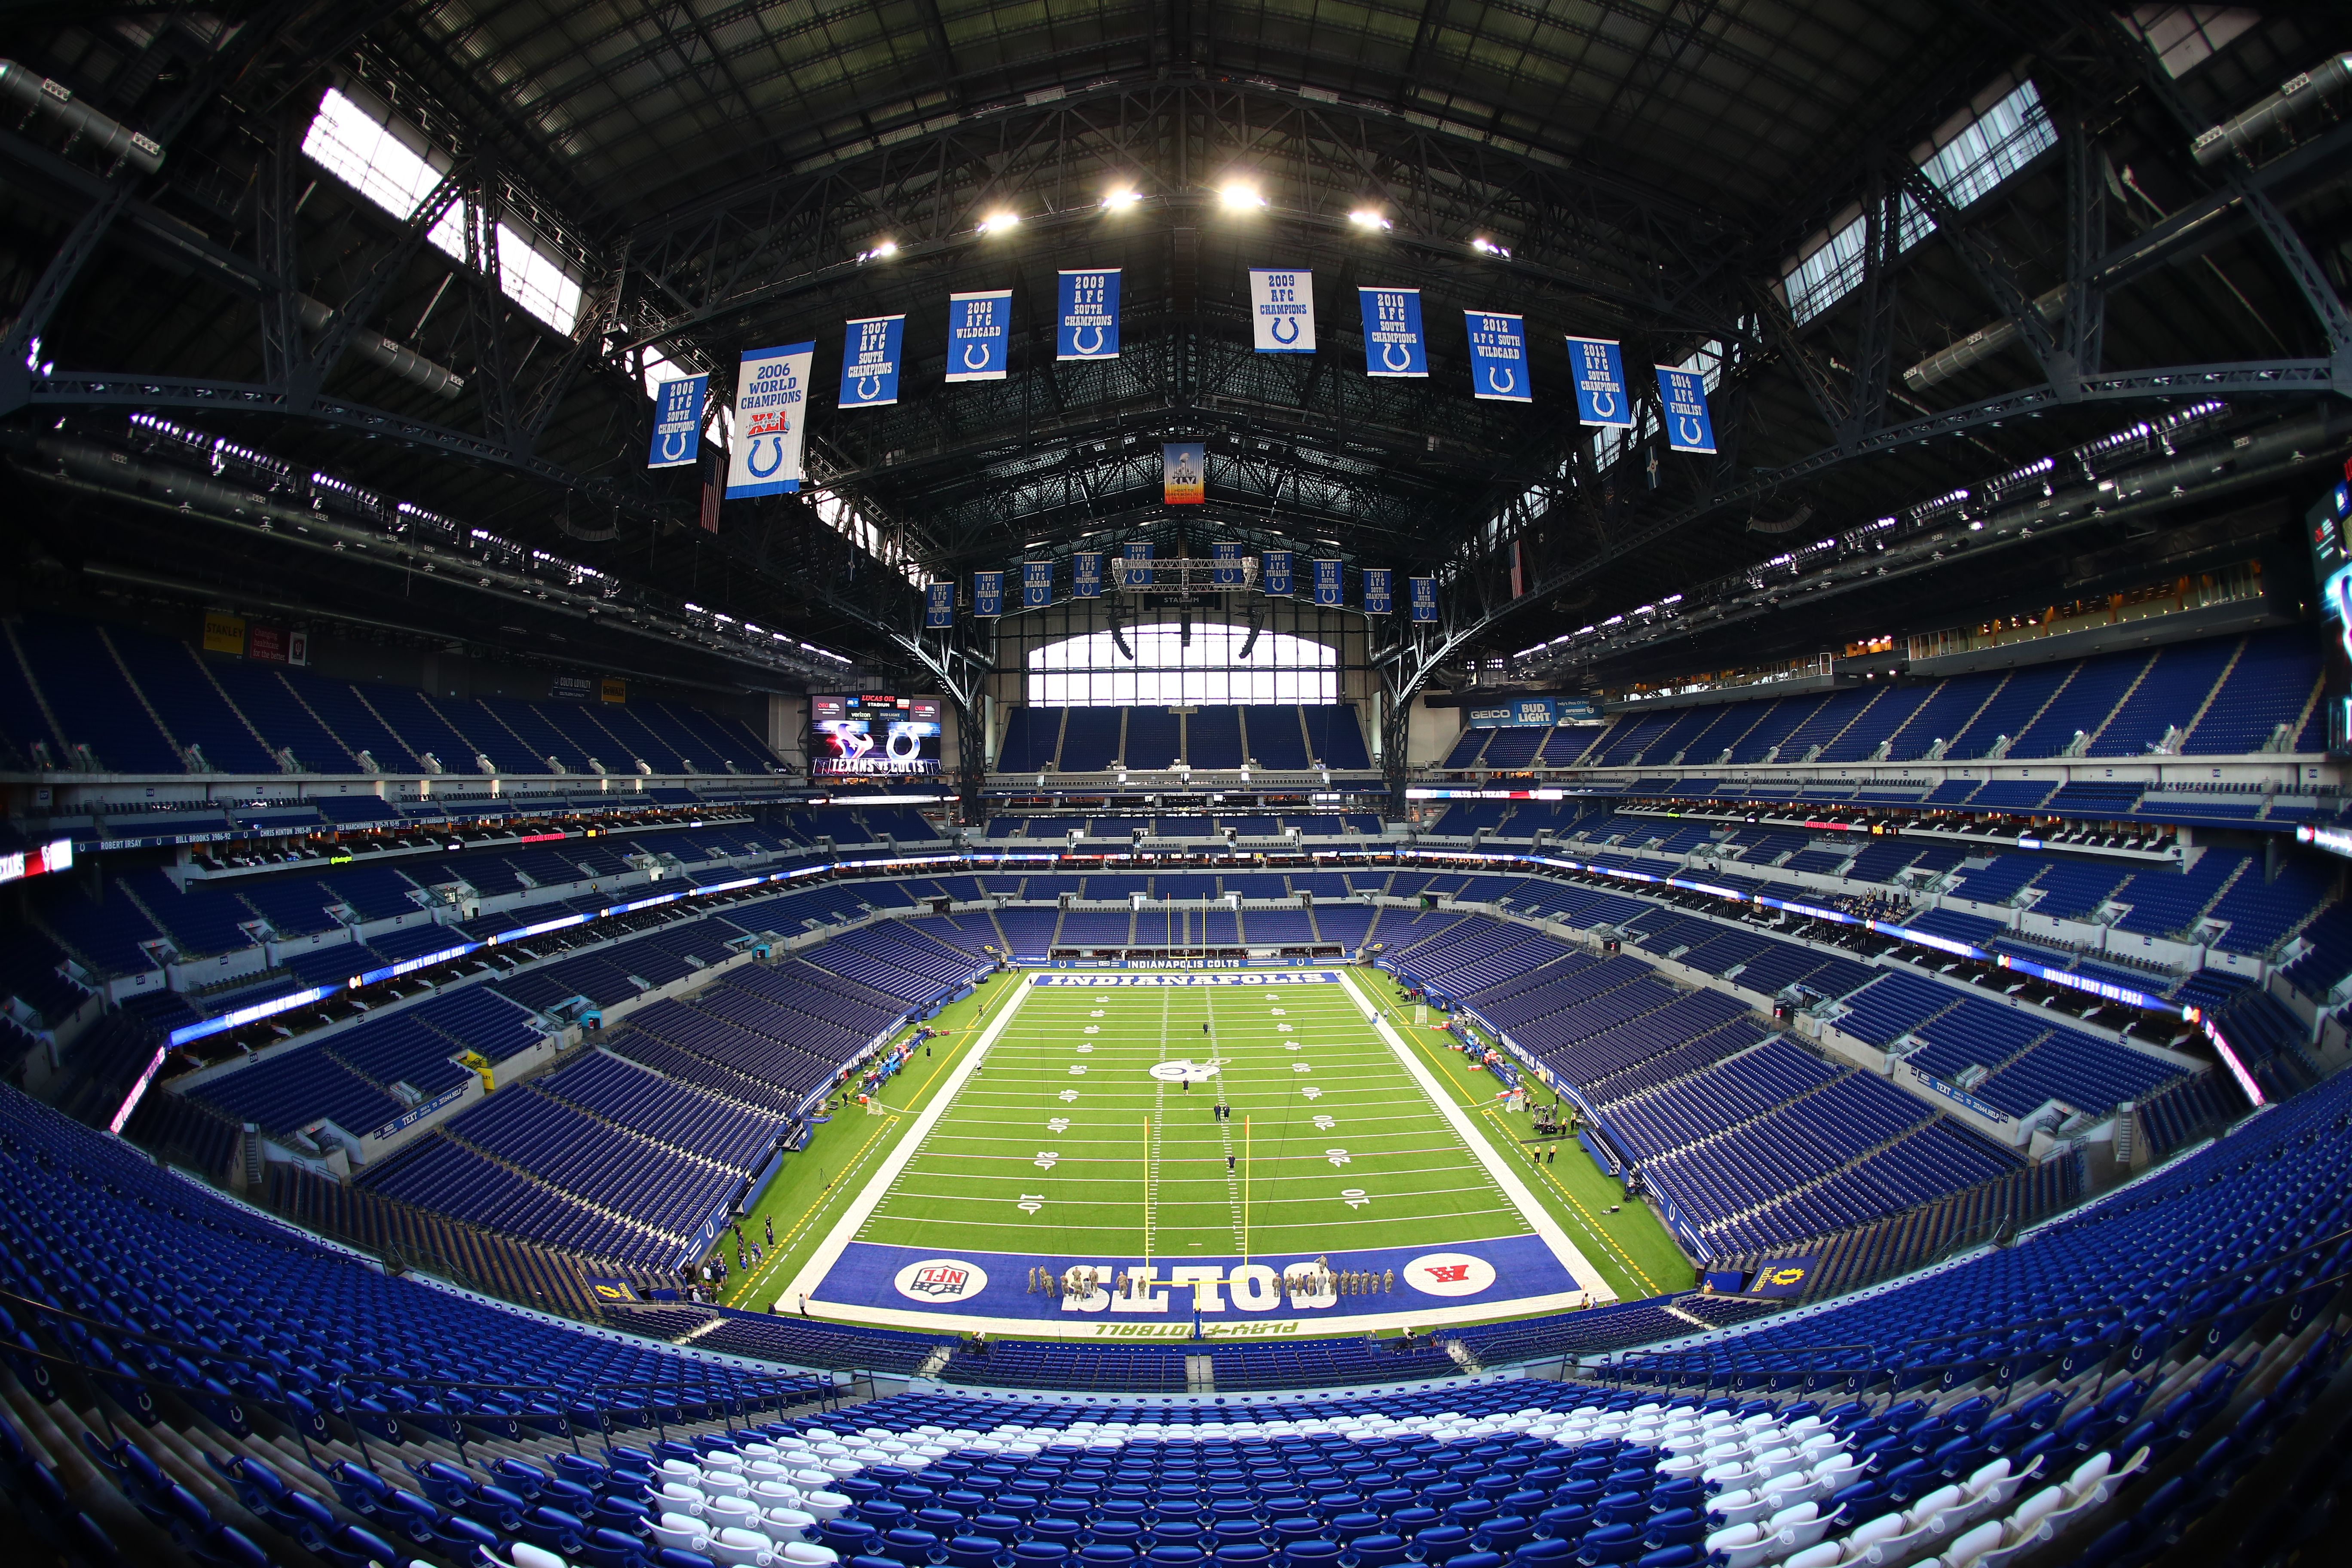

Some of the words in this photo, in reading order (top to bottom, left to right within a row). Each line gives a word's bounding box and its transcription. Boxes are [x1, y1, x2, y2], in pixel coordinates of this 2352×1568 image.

[1075, 276, 1105, 289] 2009
[1268, 275, 1295, 287] 2009
[1074, 290, 1104, 303] AFC
[1271, 289, 1294, 302] AFC
[1377, 294, 1404, 307] 2010
[967, 301, 992, 314] 2008
[1074, 304, 1102, 315] SOUTH
[1260, 304, 1307, 315] CHAMPIONS
[1379, 307, 1405, 321] AFC
[966, 314, 991, 327] AFC
[1065, 315, 1112, 327] CHAMPIONS
[1381, 321, 1406, 332] SOUTH
[1482, 318, 1508, 333] 2012
[861, 322, 888, 335] 2007
[956, 326, 1001, 339] WILDCARD
[860, 334, 885, 351] AFC
[1372, 331, 1417, 344] CHAMPIONS
[1473, 333, 1494, 343] AFC
[1498, 334, 1521, 347] SOUTH
[1477, 346, 1520, 360] WILDCARD
[1583, 344, 1606, 357] 2013
[859, 352, 883, 364] SOUTH
[1586, 357, 1608, 371] AFC
[757, 363, 790, 380] 2006
[848, 362, 892, 378] CHAMPIONS
[1588, 371, 1610, 382] SOUTH
[749, 377, 797, 395] WORLD
[1580, 380, 1620, 393] CHAMPIONS
[1670, 374, 1691, 388] 2014
[670, 381, 694, 395] 2006
[669, 394, 692, 410] AFC
[741, 390, 801, 410] CHAMPIONS
[1675, 389, 1694, 403] AFC
[1670, 401, 1703, 416] FINALIST
[667, 410, 689, 422] SOUTH
[658, 421, 695, 434] CHAMPIONS
[1080, 562, 1095, 570] AFC
[1370, 578, 1384, 586] AFC
[932, 592, 946, 600] AFC
[1417, 586, 1430, 594] AFC
[206, 623, 243, 638] STANLEY
[254, 628, 278, 640] Changing
[254, 639, 279, 649] healthcare
[261, 650, 270, 658] the
[560, 677, 573, 687] COLTS
[574, 679, 591, 689] LOYALTY
[1470, 709, 1510, 719] GEICO
[1521, 703, 1545, 713] BUD
[1518, 713, 1550, 722] LIGHT
[832, 759, 874, 772] TEXANS
[891, 760, 924, 773] COLTS
[101, 840, 123, 850] ROBERT
[125, 839, 142, 848] IRSAY
[189, 834, 209, 842] BROOKS
[393, 957, 423, 975] INDIANA'S
[423, 954, 437, 966] VERY
[1127, 960, 1204, 968] INDIANAPOLIS
[1207, 959, 1240, 968] COLTS
[1047, 973, 1327, 986] INDIANAPOLIS
[2044, 968, 2079, 988] INDIANA'S
[2081, 978, 2101, 993] VERY
[2102, 983, 2120, 999] OWN
[2121, 989, 2143, 1005] CBS4
[873, 1030, 887, 1049] COLTS
[1068, 1065, 1087, 1075] 50
[1291, 1063, 1311, 1072] 50
[1058, 1089, 1079, 1100] 40
[1301, 1087, 1323, 1098] 40
[1936, 1082, 1951, 1095] TEXT
[402, 1112, 417, 1126] TEXT
[1047, 1117, 1070, 1130] 30
[1312, 1115, 1335, 1127] 30
[384, 1124, 394, 1132] NEED
[1033, 1152, 1059, 1166] 20
[1325, 1149, 1351, 1163] 20
[1017, 1194, 1045, 1210] 10
[1341, 1189, 1370, 1205] 10
[921, 1269, 965, 1285] NFL
[1751, 1266, 1776, 1292] Indiana
[618, 1282, 637, 1301] Indiana
[1060, 1262, 1338, 1314] COLTS
[1231, 1322, 1298, 1334] PLAY
